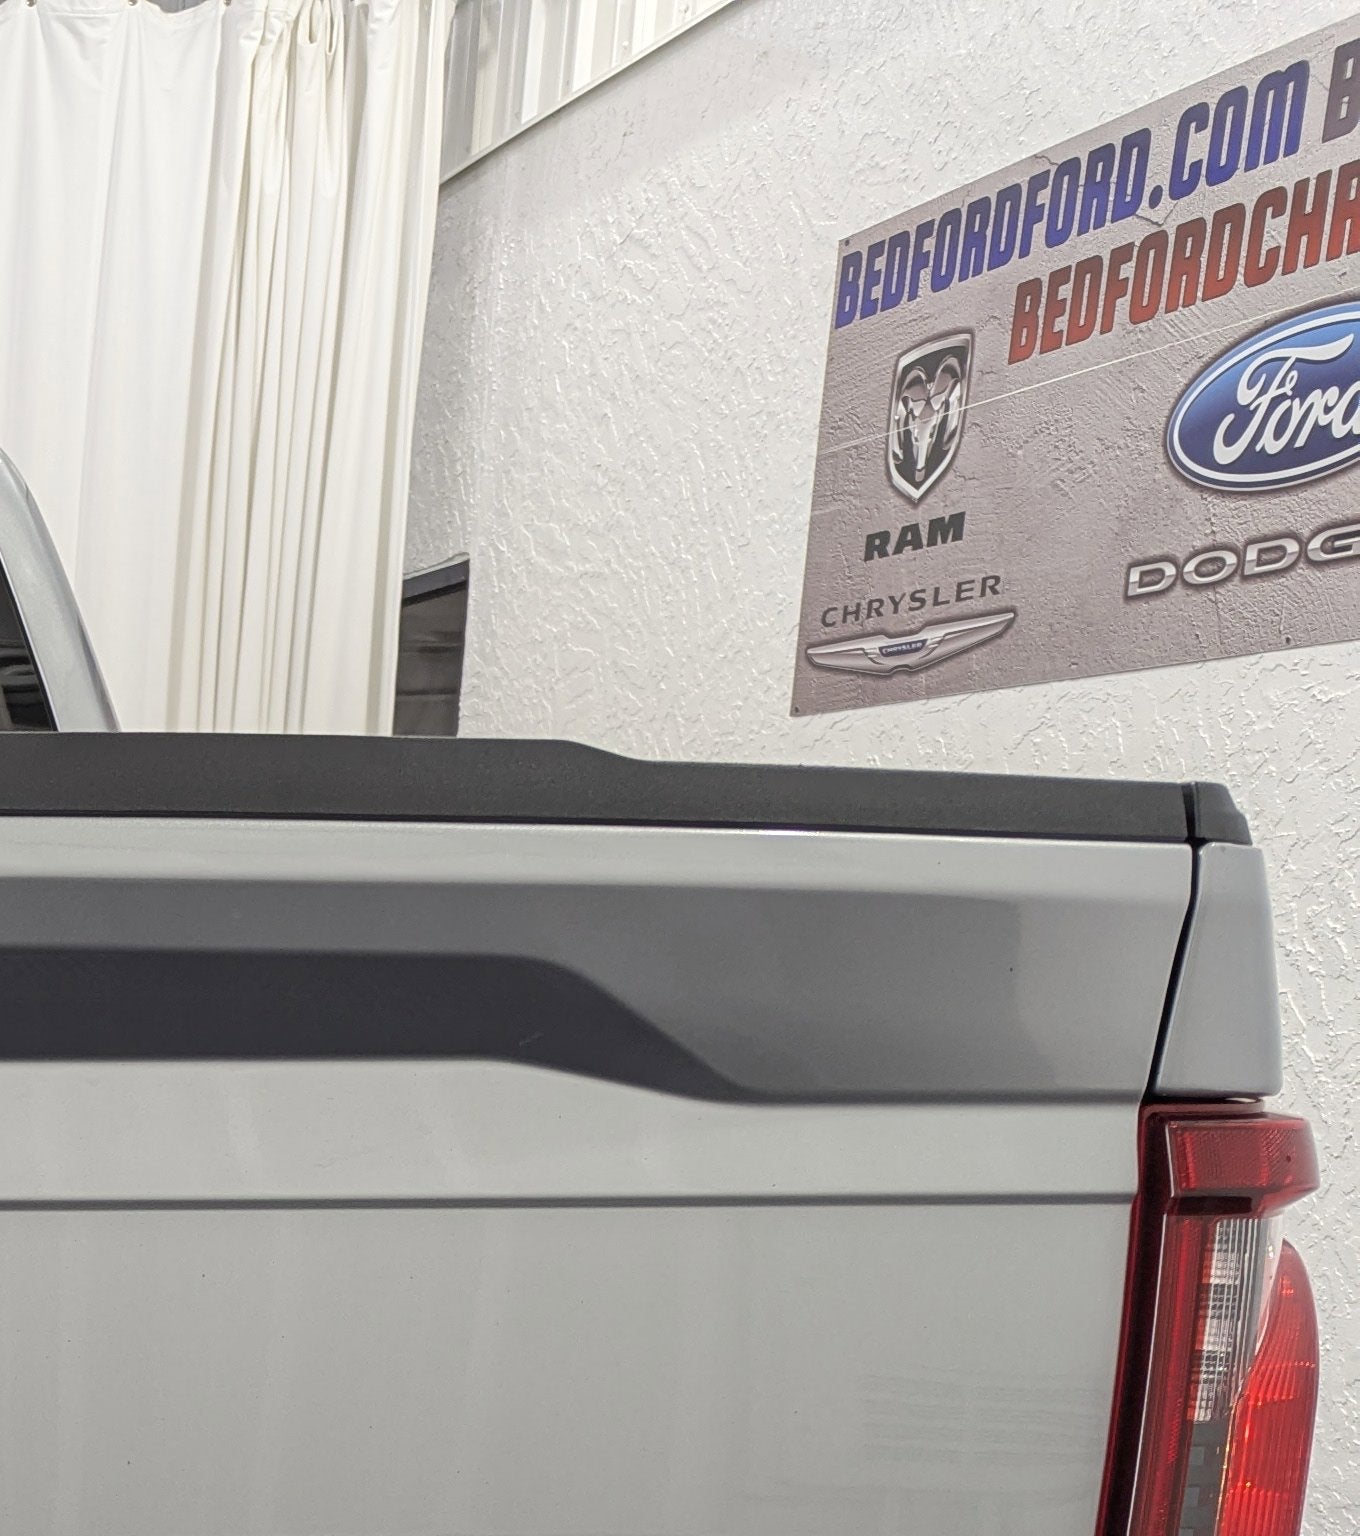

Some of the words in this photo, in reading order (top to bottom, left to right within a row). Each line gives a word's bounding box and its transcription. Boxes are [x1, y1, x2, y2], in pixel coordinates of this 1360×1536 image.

[835, 60, 1310, 329] BEDFORDFORD.COM
[864, 511, 966, 562] RAM
[821, 575, 1001, 627] CHRYSLER
